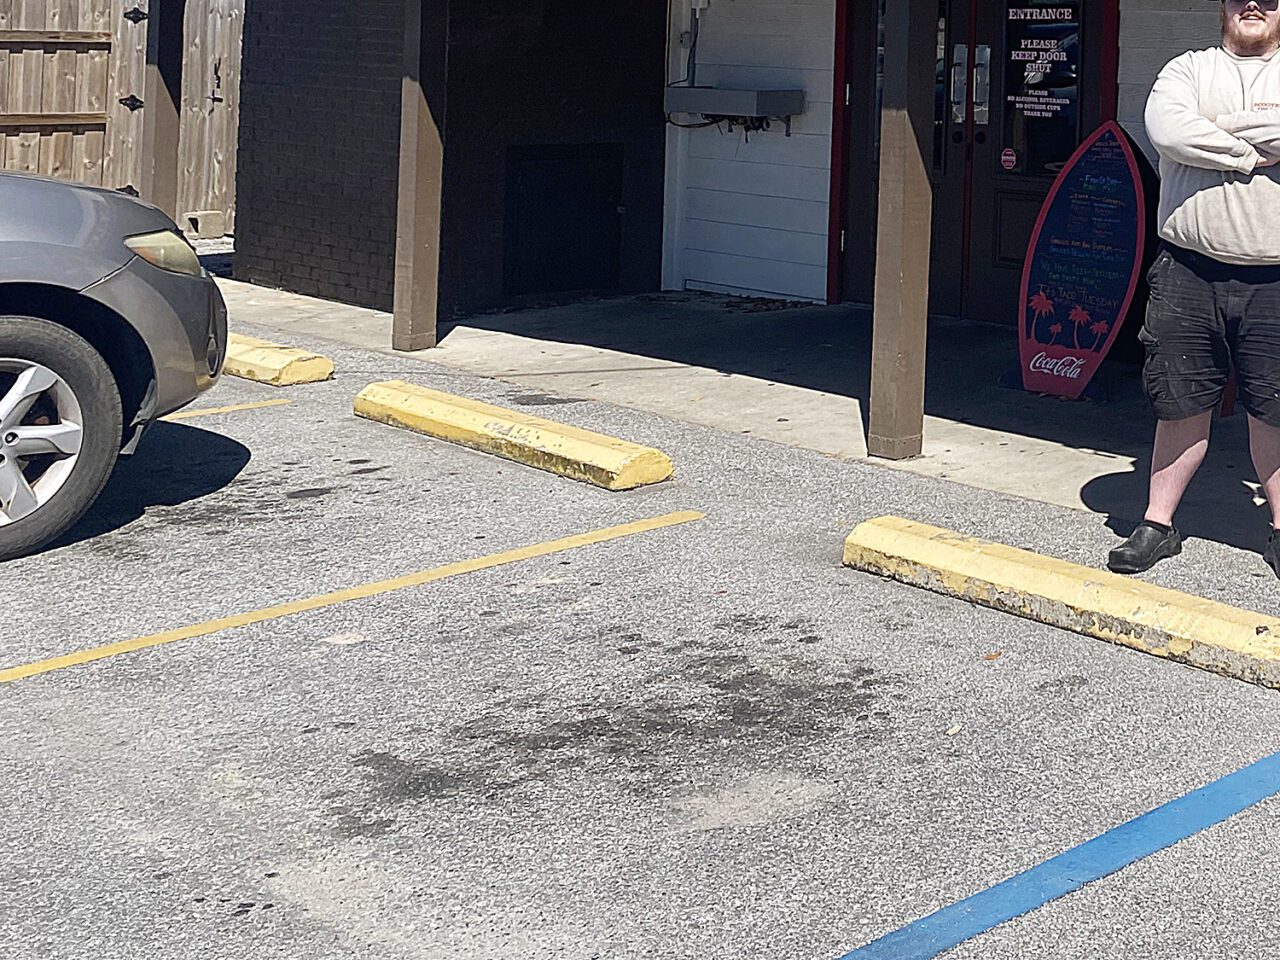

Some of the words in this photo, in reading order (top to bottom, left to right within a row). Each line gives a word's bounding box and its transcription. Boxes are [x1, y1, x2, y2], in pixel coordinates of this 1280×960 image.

[1008, 9, 1072, 19] ENTRANCE
[1021, 40, 1057, 48] PLEASE
[1011, 51, 1037, 60] KEEP
[1040, 52, 1067, 61] DOOR
[1026, 63, 1052, 72] SHUT
